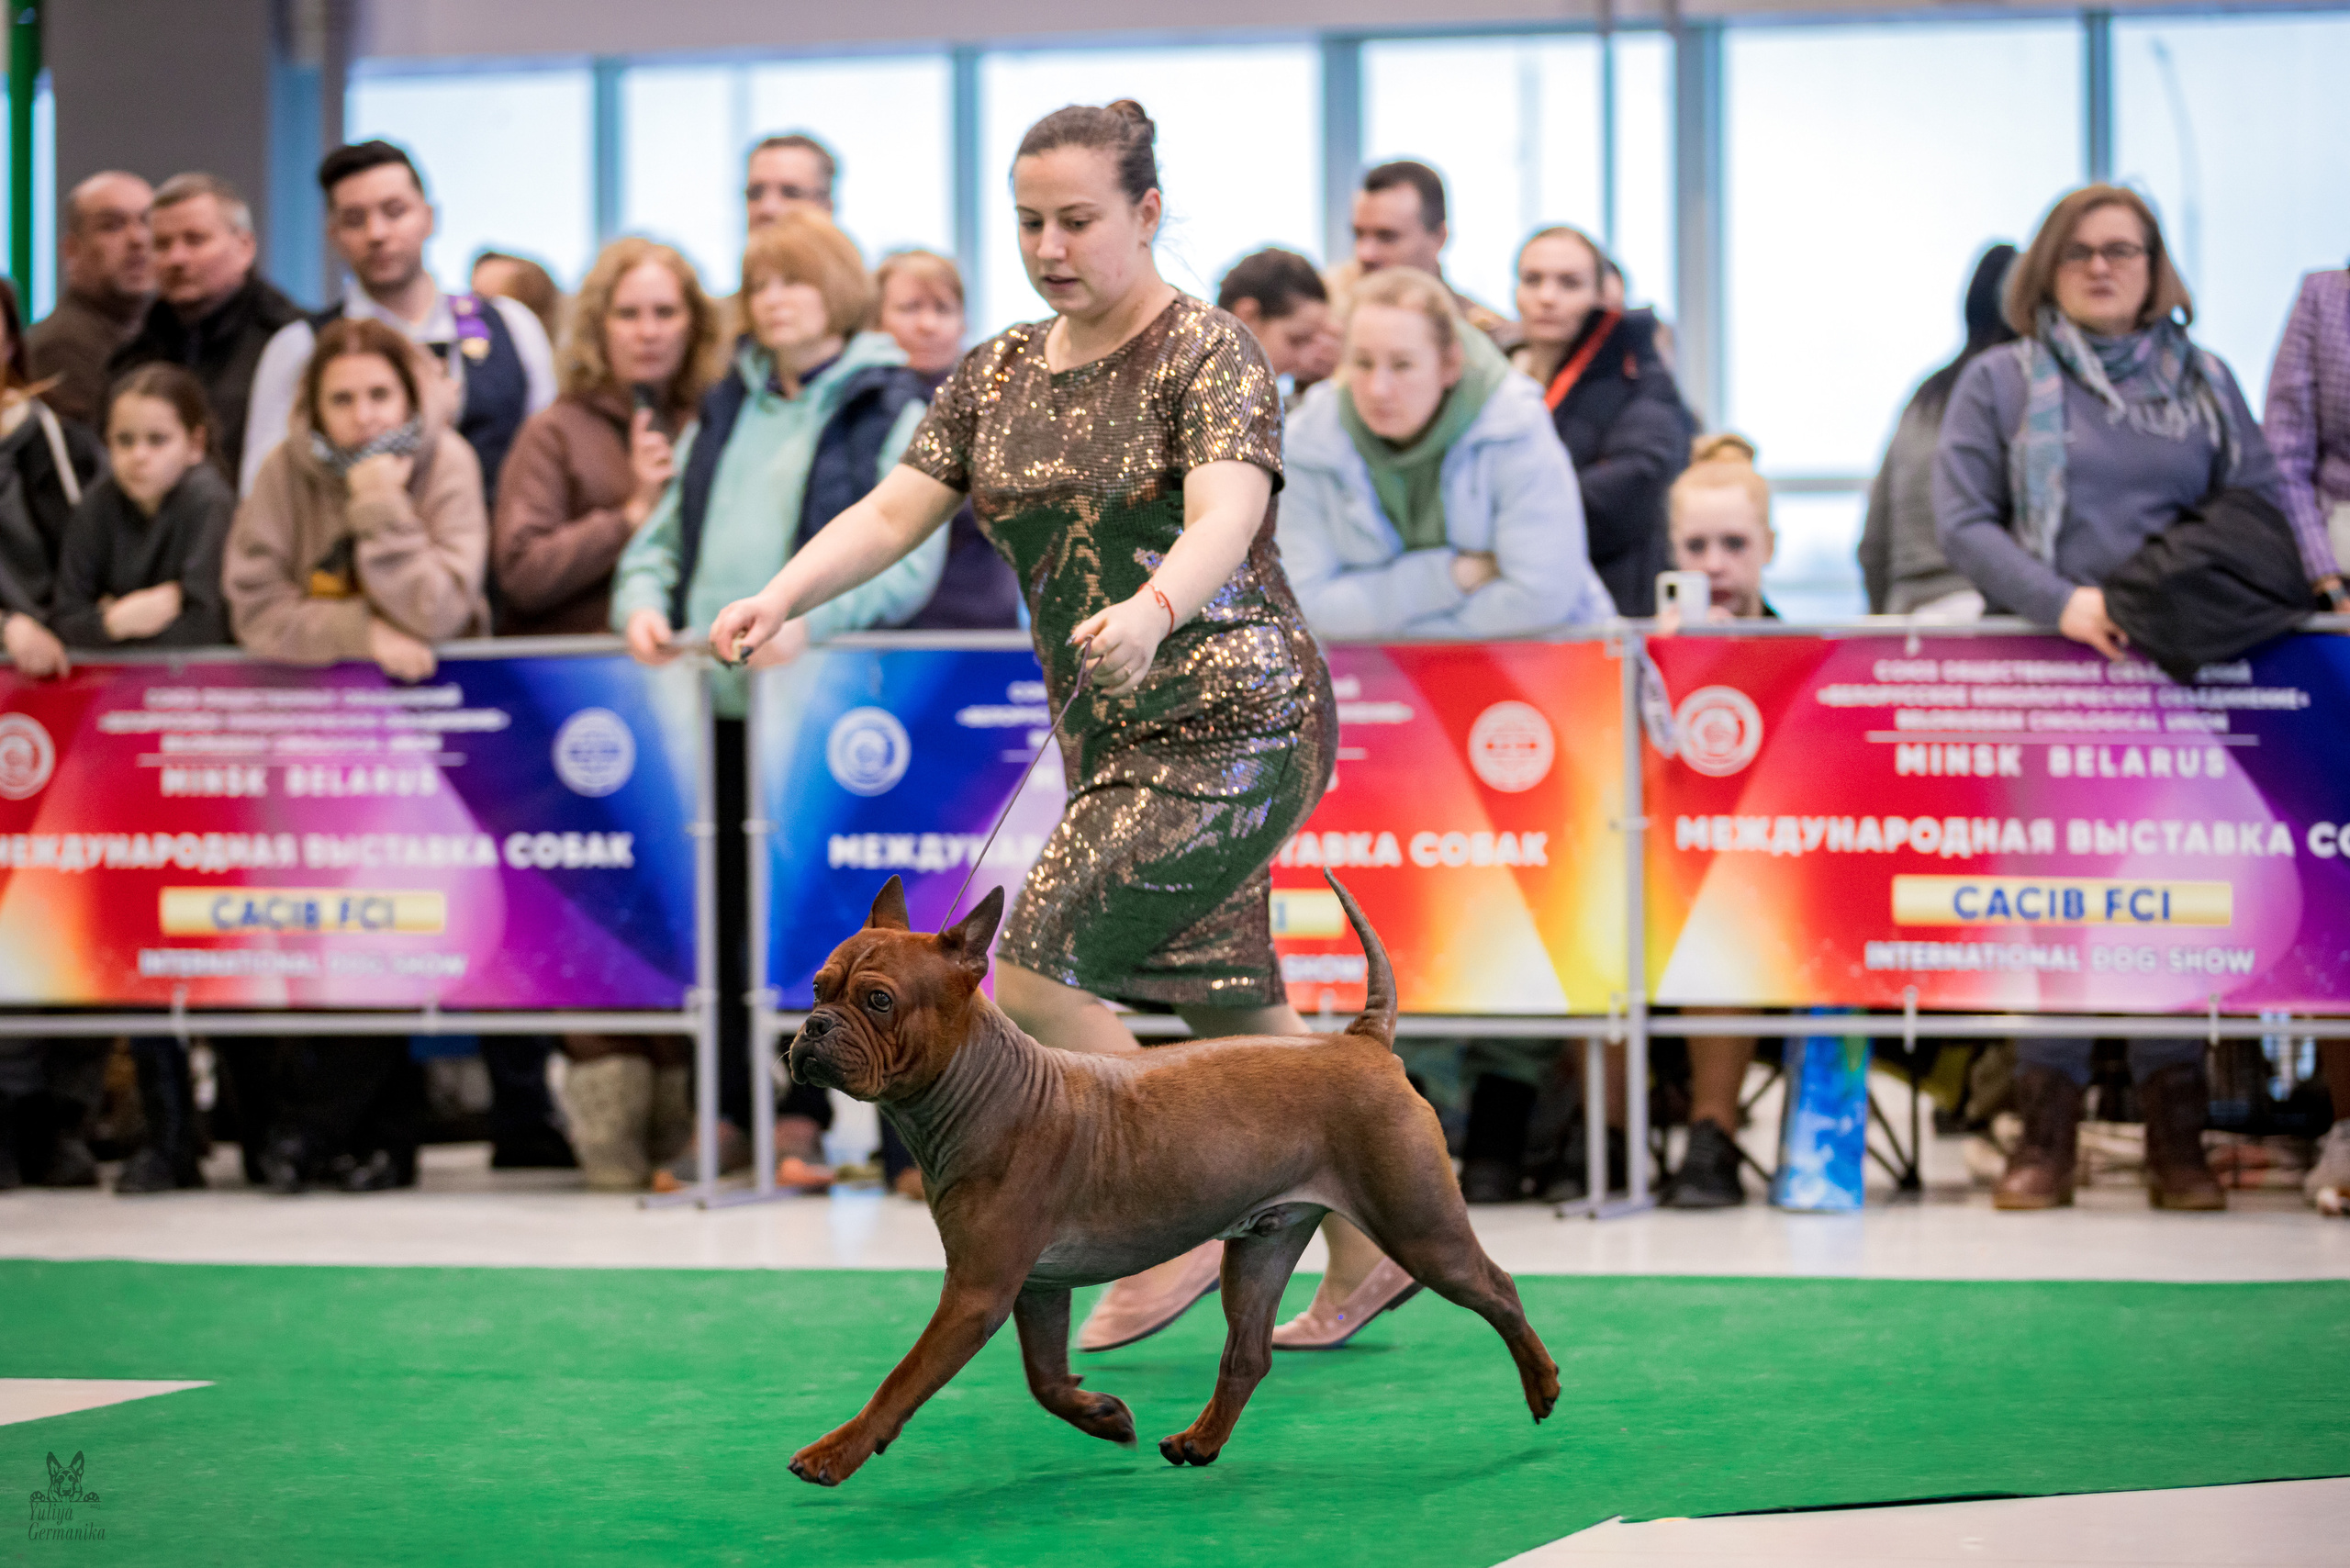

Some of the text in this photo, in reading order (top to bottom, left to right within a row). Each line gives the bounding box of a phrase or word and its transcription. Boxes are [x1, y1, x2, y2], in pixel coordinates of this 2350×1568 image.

[1896, 744, 2228, 778] MINSK BELARUS
[505, 832, 634, 869] СОБАК
[1409, 831, 1549, 868] СОБАК
[1676, 815, 2056, 858] МЕЖДУНАРОДНАЯ
[2068, 818, 2296, 857] ВЫСТАВКА
[1950, 886, 2171, 923] CACIB FCI
